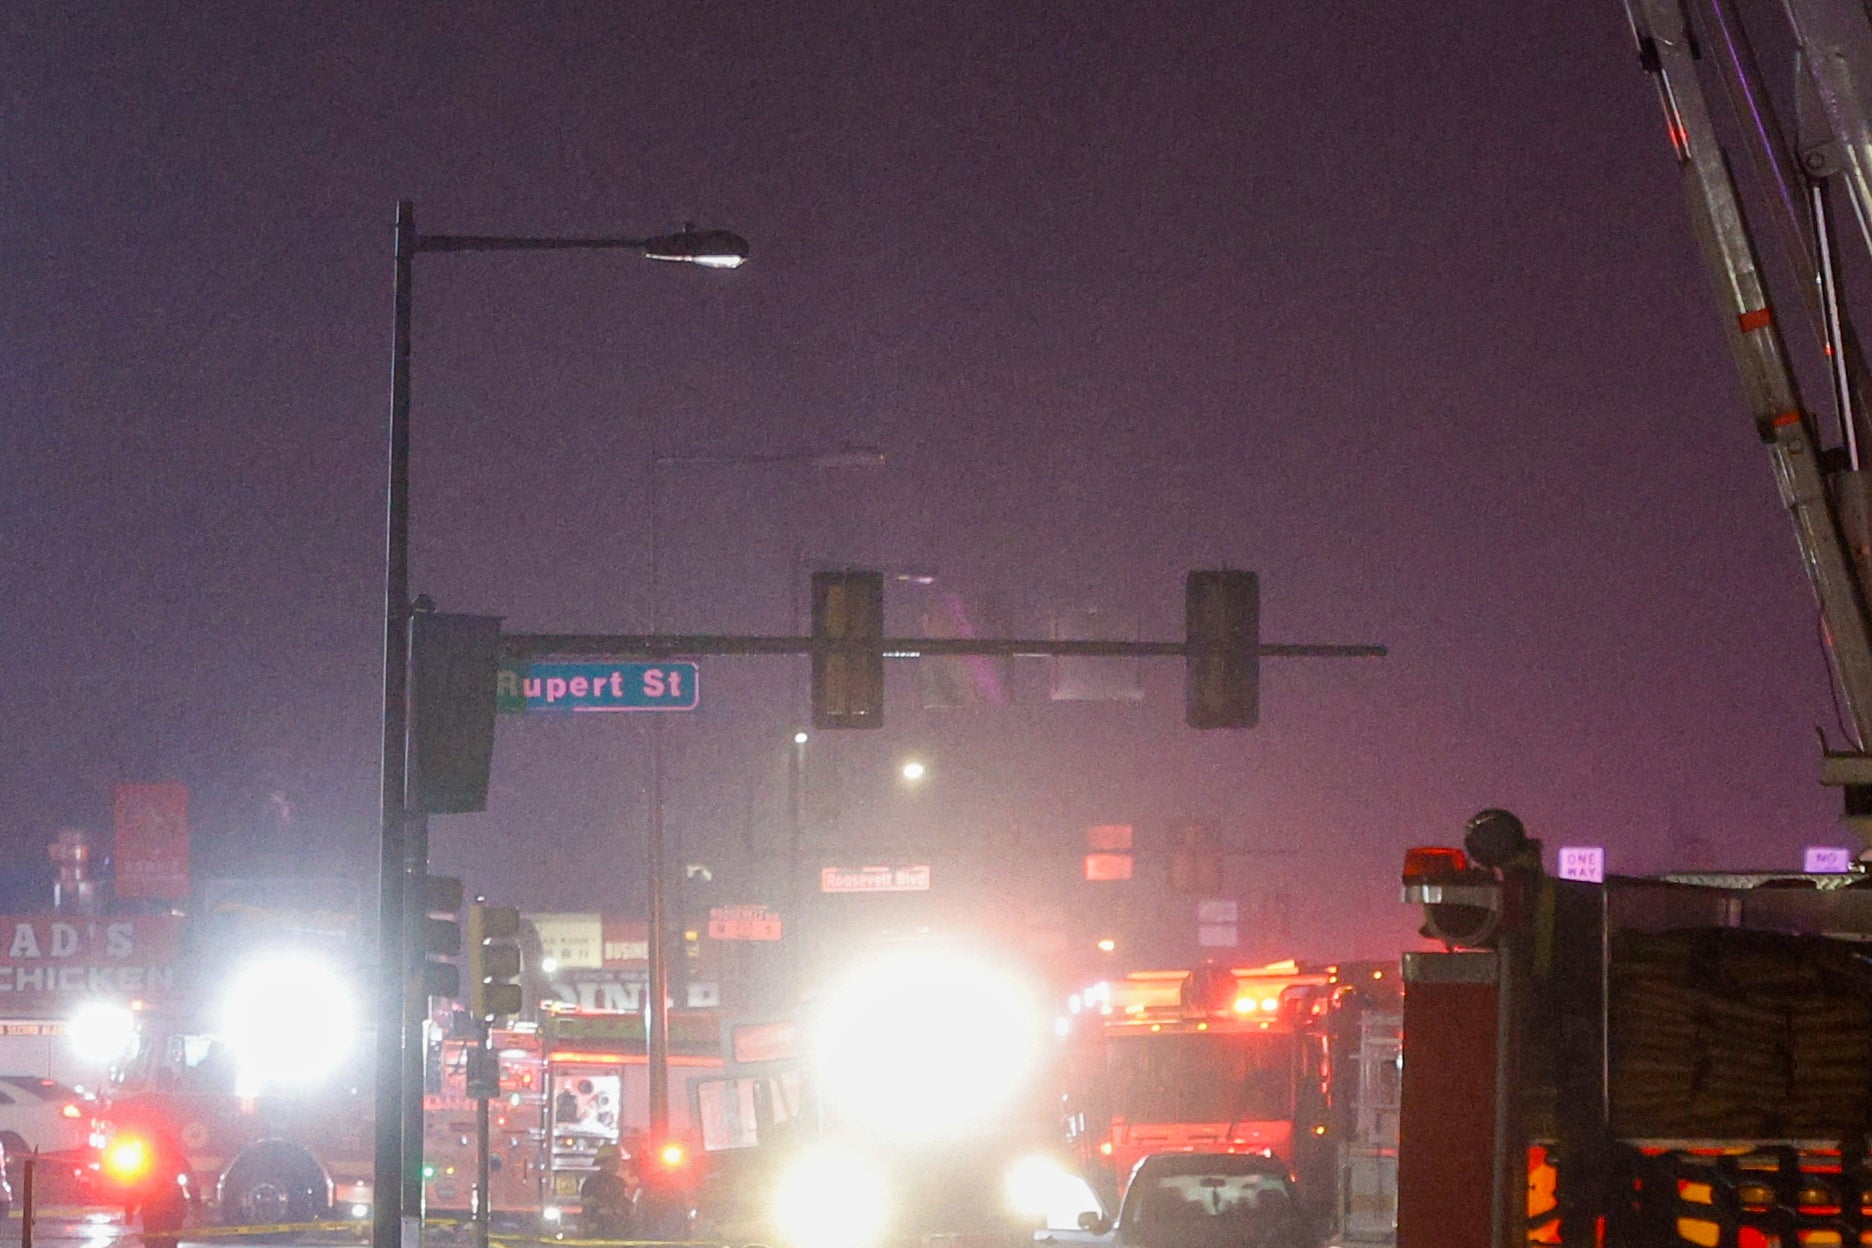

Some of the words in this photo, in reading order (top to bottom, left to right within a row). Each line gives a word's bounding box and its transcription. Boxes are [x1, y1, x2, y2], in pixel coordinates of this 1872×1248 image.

[497, 670, 624, 703] Rupert
[642, 668, 682, 697] St
[1567, 854, 1595, 865] ONE
[1567, 867, 1596, 877] WAY
